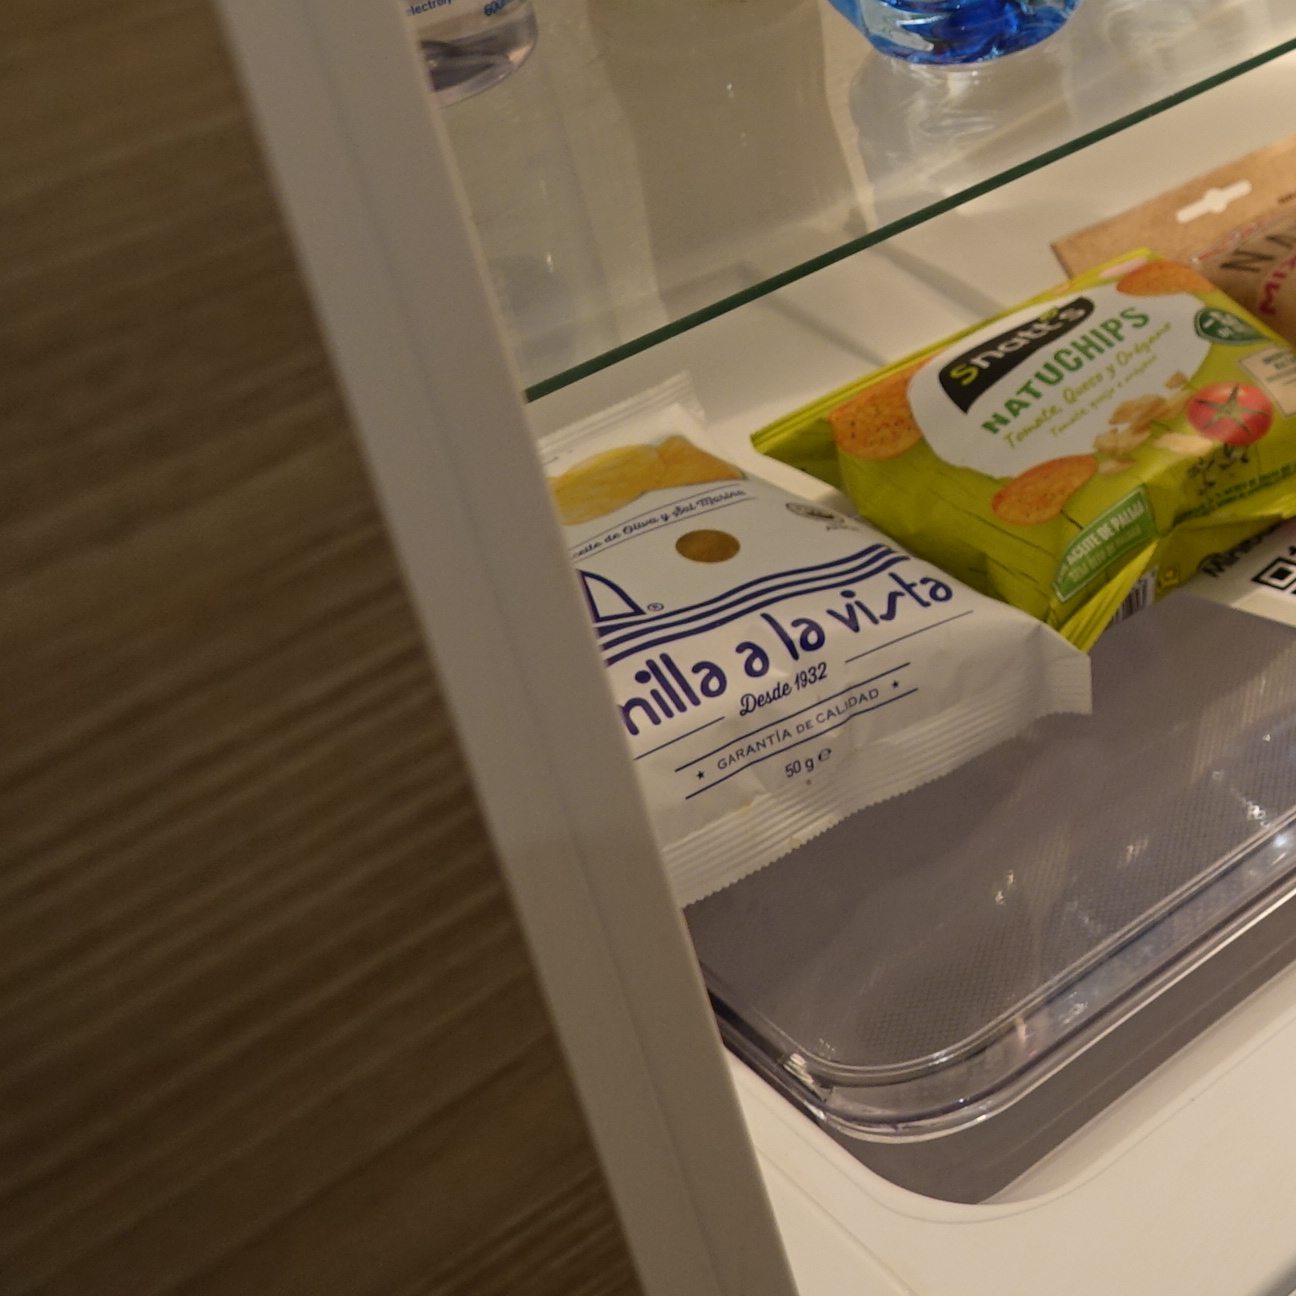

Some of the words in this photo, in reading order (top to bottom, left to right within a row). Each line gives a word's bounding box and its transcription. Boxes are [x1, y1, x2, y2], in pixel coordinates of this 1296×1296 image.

[980, 306, 1151, 435] NATUCHIPS
[1003, 405, 1063, 449] Tomate,
[1061, 370, 1105, 404] Queso
[622, 516, 660, 536] Oliva
[660, 508, 671, 525] y
[734, 640, 770, 679] a
[760, 612, 826, 661] la
[825, 571, 954, 633] vista
[716, 726, 793, 771] GARANTÍA
[795, 718, 814, 735] DE
[815, 687, 881, 725] CALIDAD
[738, 681, 793, 718] Desde
[793, 661, 829, 692] 1932
[784, 758, 802, 778] 50
[804, 757, 816, 774] g
